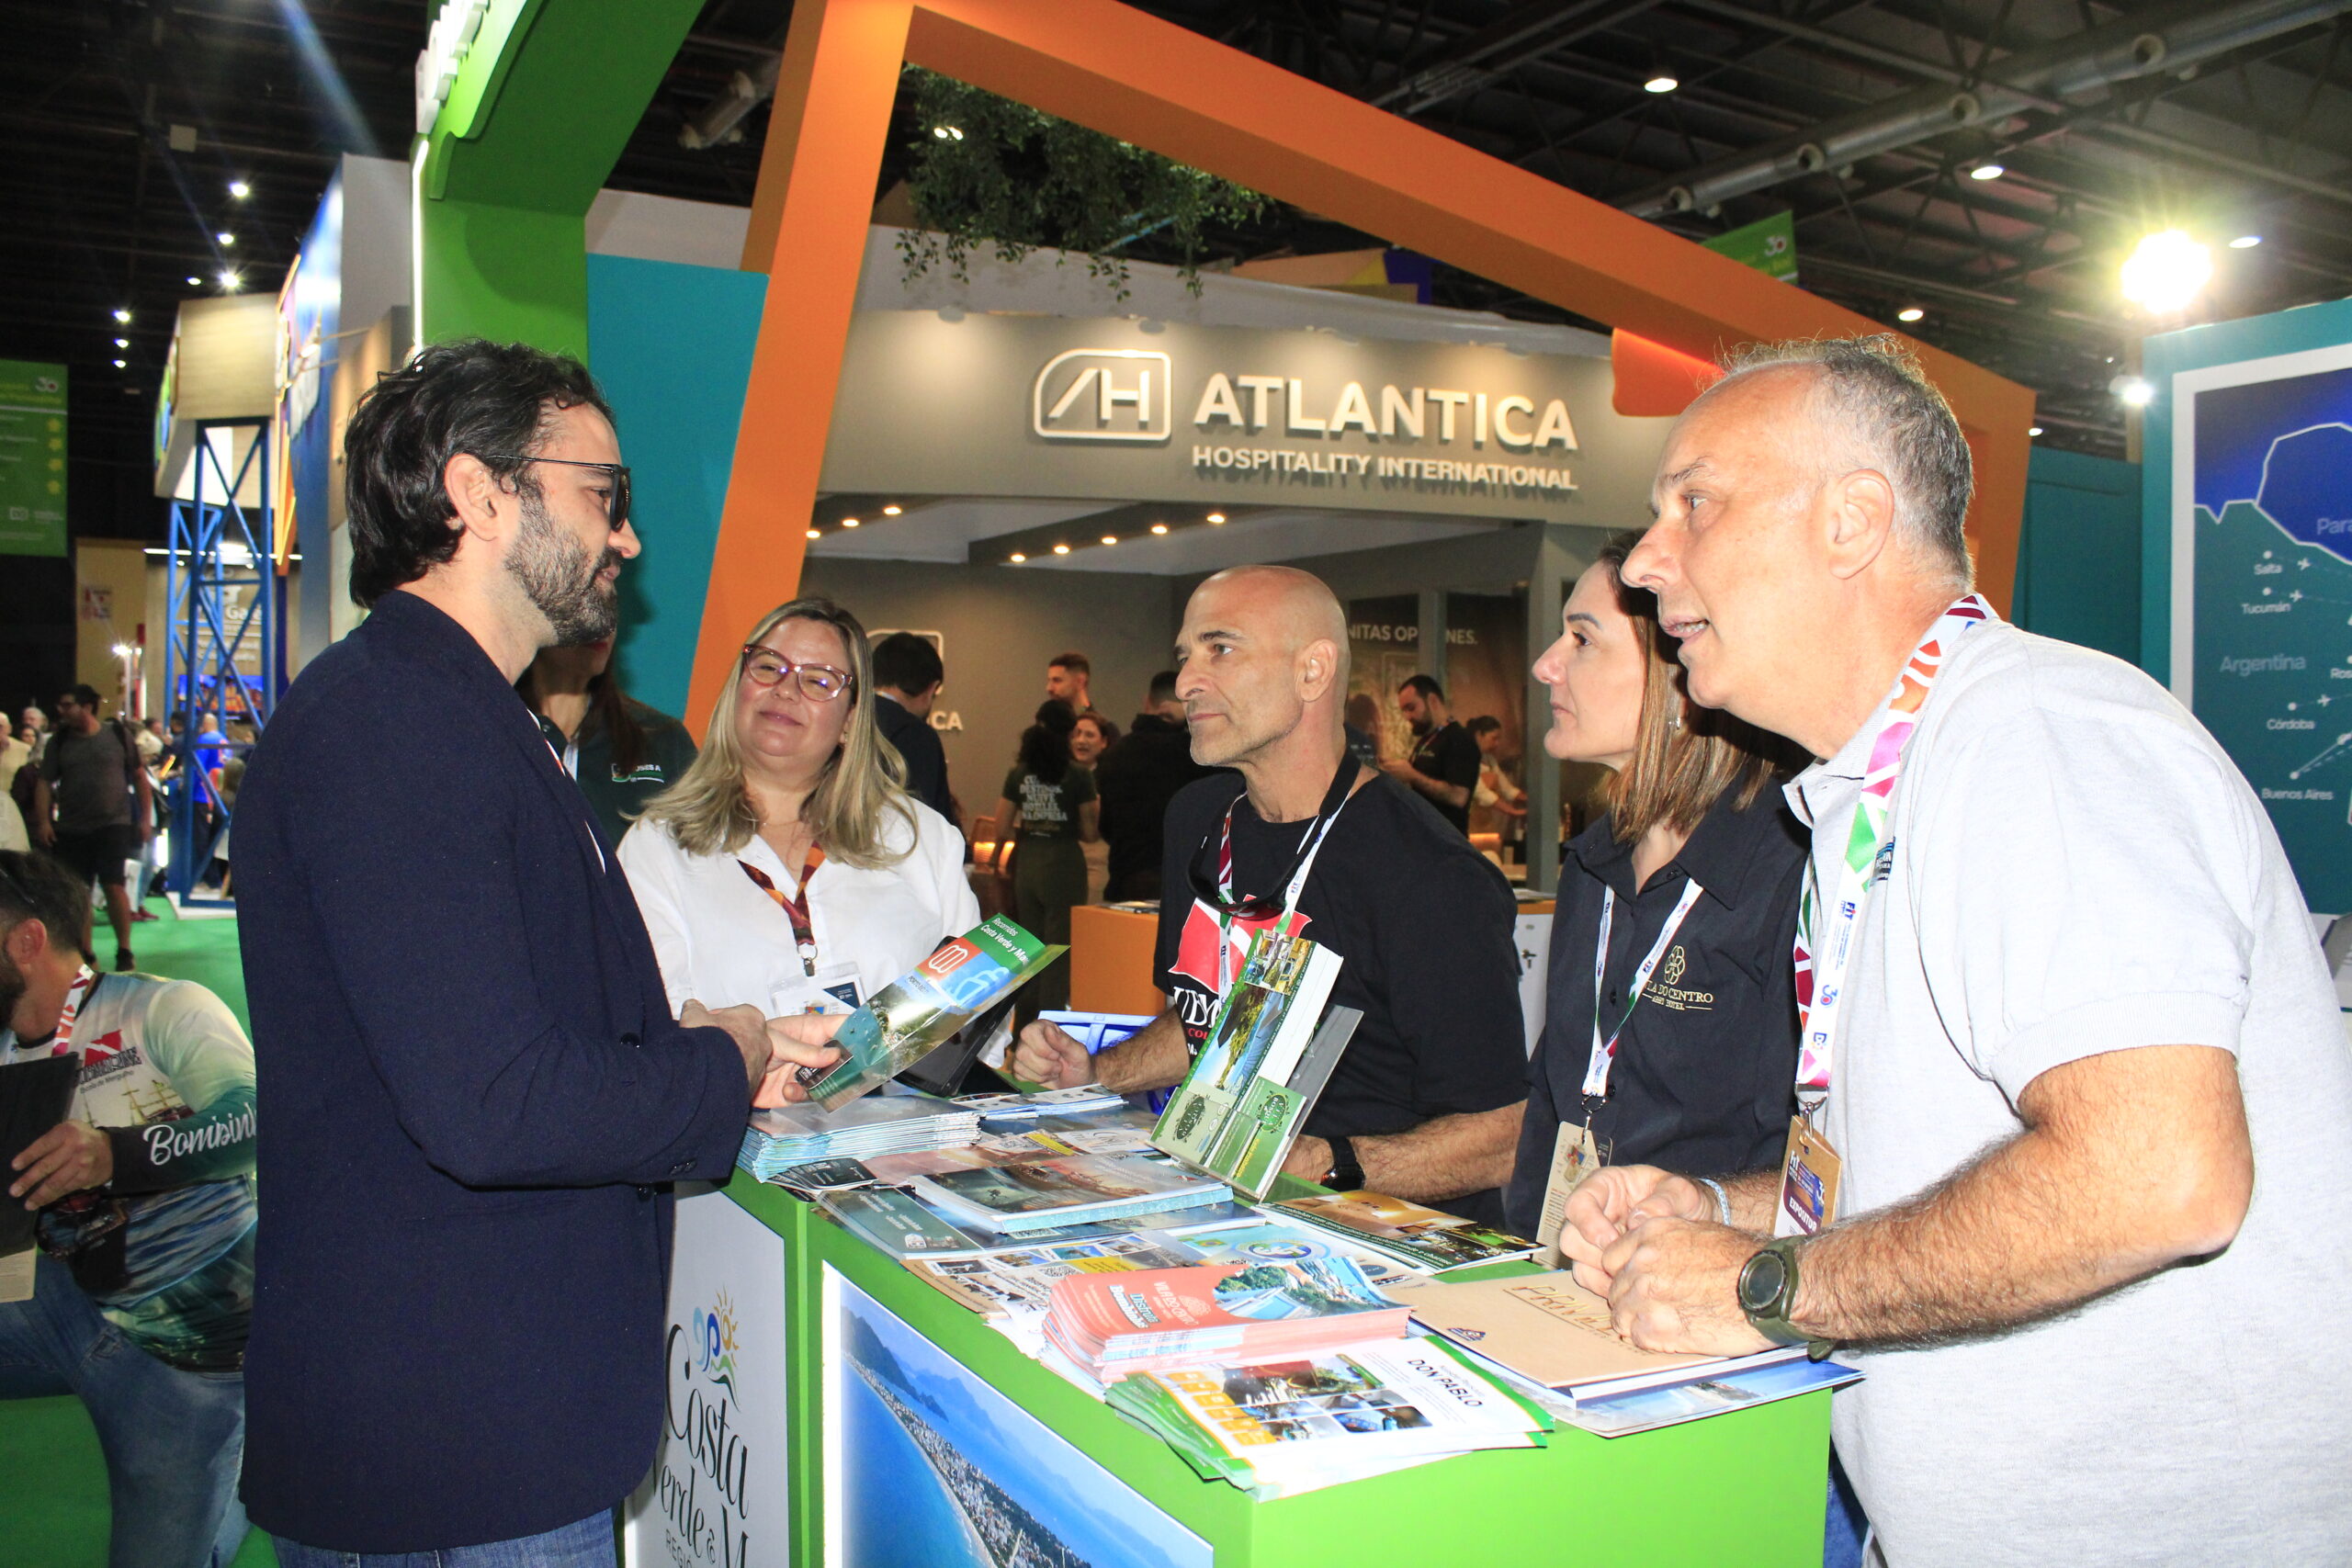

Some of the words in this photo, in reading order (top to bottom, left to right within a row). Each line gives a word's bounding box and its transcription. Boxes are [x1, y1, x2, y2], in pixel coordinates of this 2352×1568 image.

[1194, 373, 1578, 450] ATLANTICA
[1193, 446, 1372, 476] HOSPITALITY
[1378, 457, 1578, 490] INTERNATIONAL
[2317, 517, 2352, 535] Para
[2254, 563, 2283, 575] Salta
[2242, 602, 2290, 615] Tucumán
[1348, 624, 1391, 641] NITAS
[1395, 626, 1478, 644] OPNES.
[2220, 654, 2306, 677] Argentina
[2267, 717, 2314, 731] Córdoba
[2262, 787, 2302, 800] Buenos
[2303, 787, 2334, 801] Aires
[1845, 900, 1856, 920] FIT
[980, 924, 995, 938] Costa
[994, 932, 1012, 949] Verde
[992, 918, 1019, 937] Recorridos
[1657, 984, 1668, 997] DO
[1668, 987, 1713, 1003] CENTRO
[1407, 1359, 1442, 1378] DON
[1432, 1377, 1484, 1408] PABLO
[664, 1324, 750, 1519] Costa
[652, 1459, 705, 1559] erde
